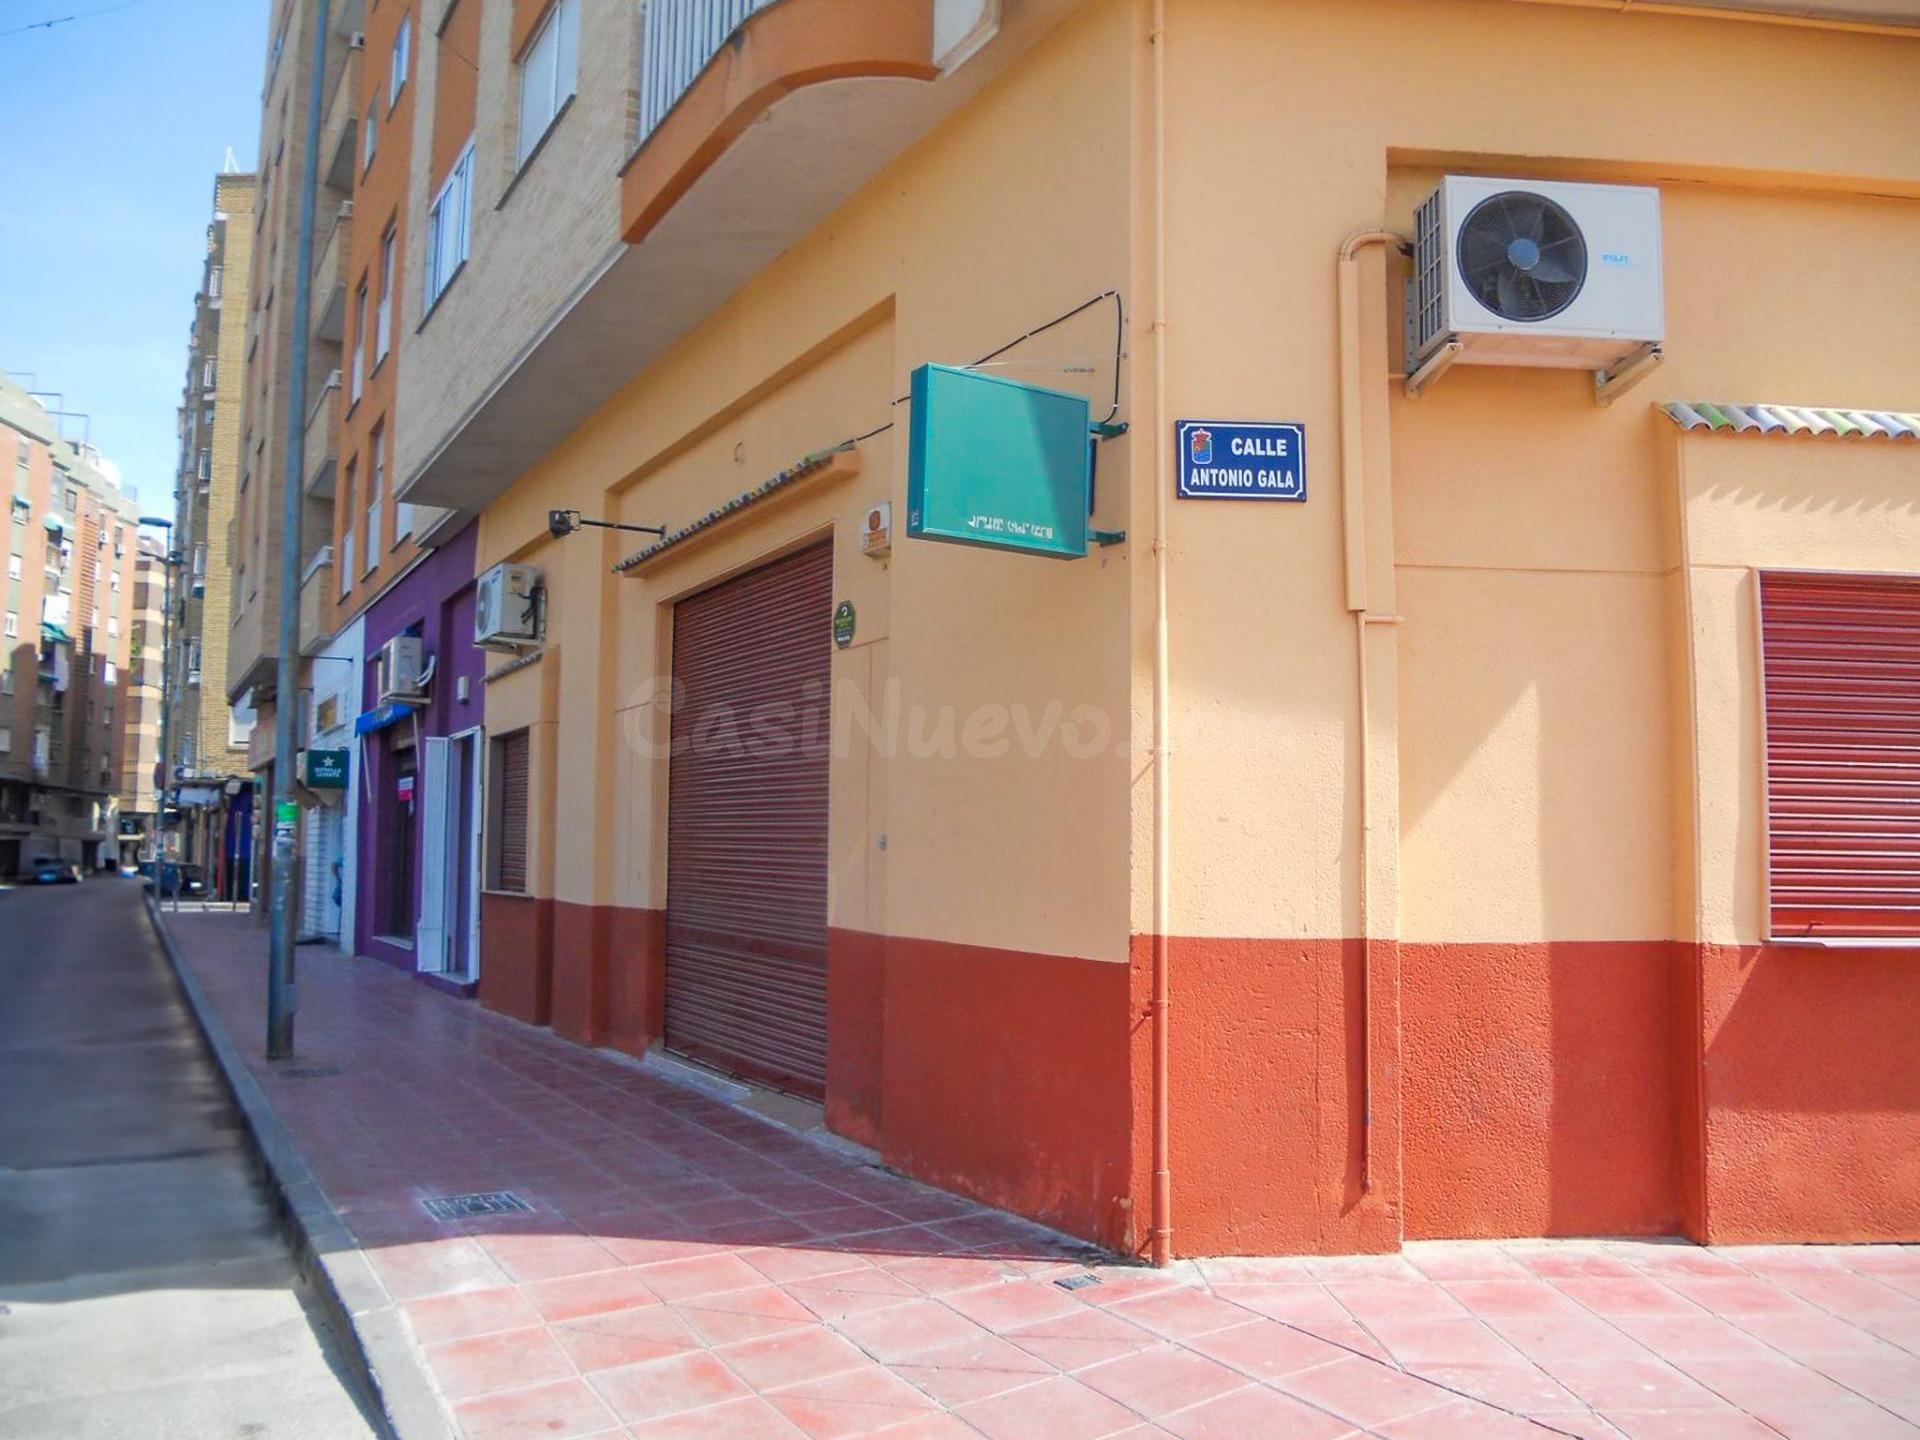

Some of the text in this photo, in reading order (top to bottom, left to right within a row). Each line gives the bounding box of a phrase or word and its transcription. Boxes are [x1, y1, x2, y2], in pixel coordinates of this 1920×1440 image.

[1231, 437, 1288, 456] CALLE
[1190, 468, 1294, 488] ANTONIO GALA
